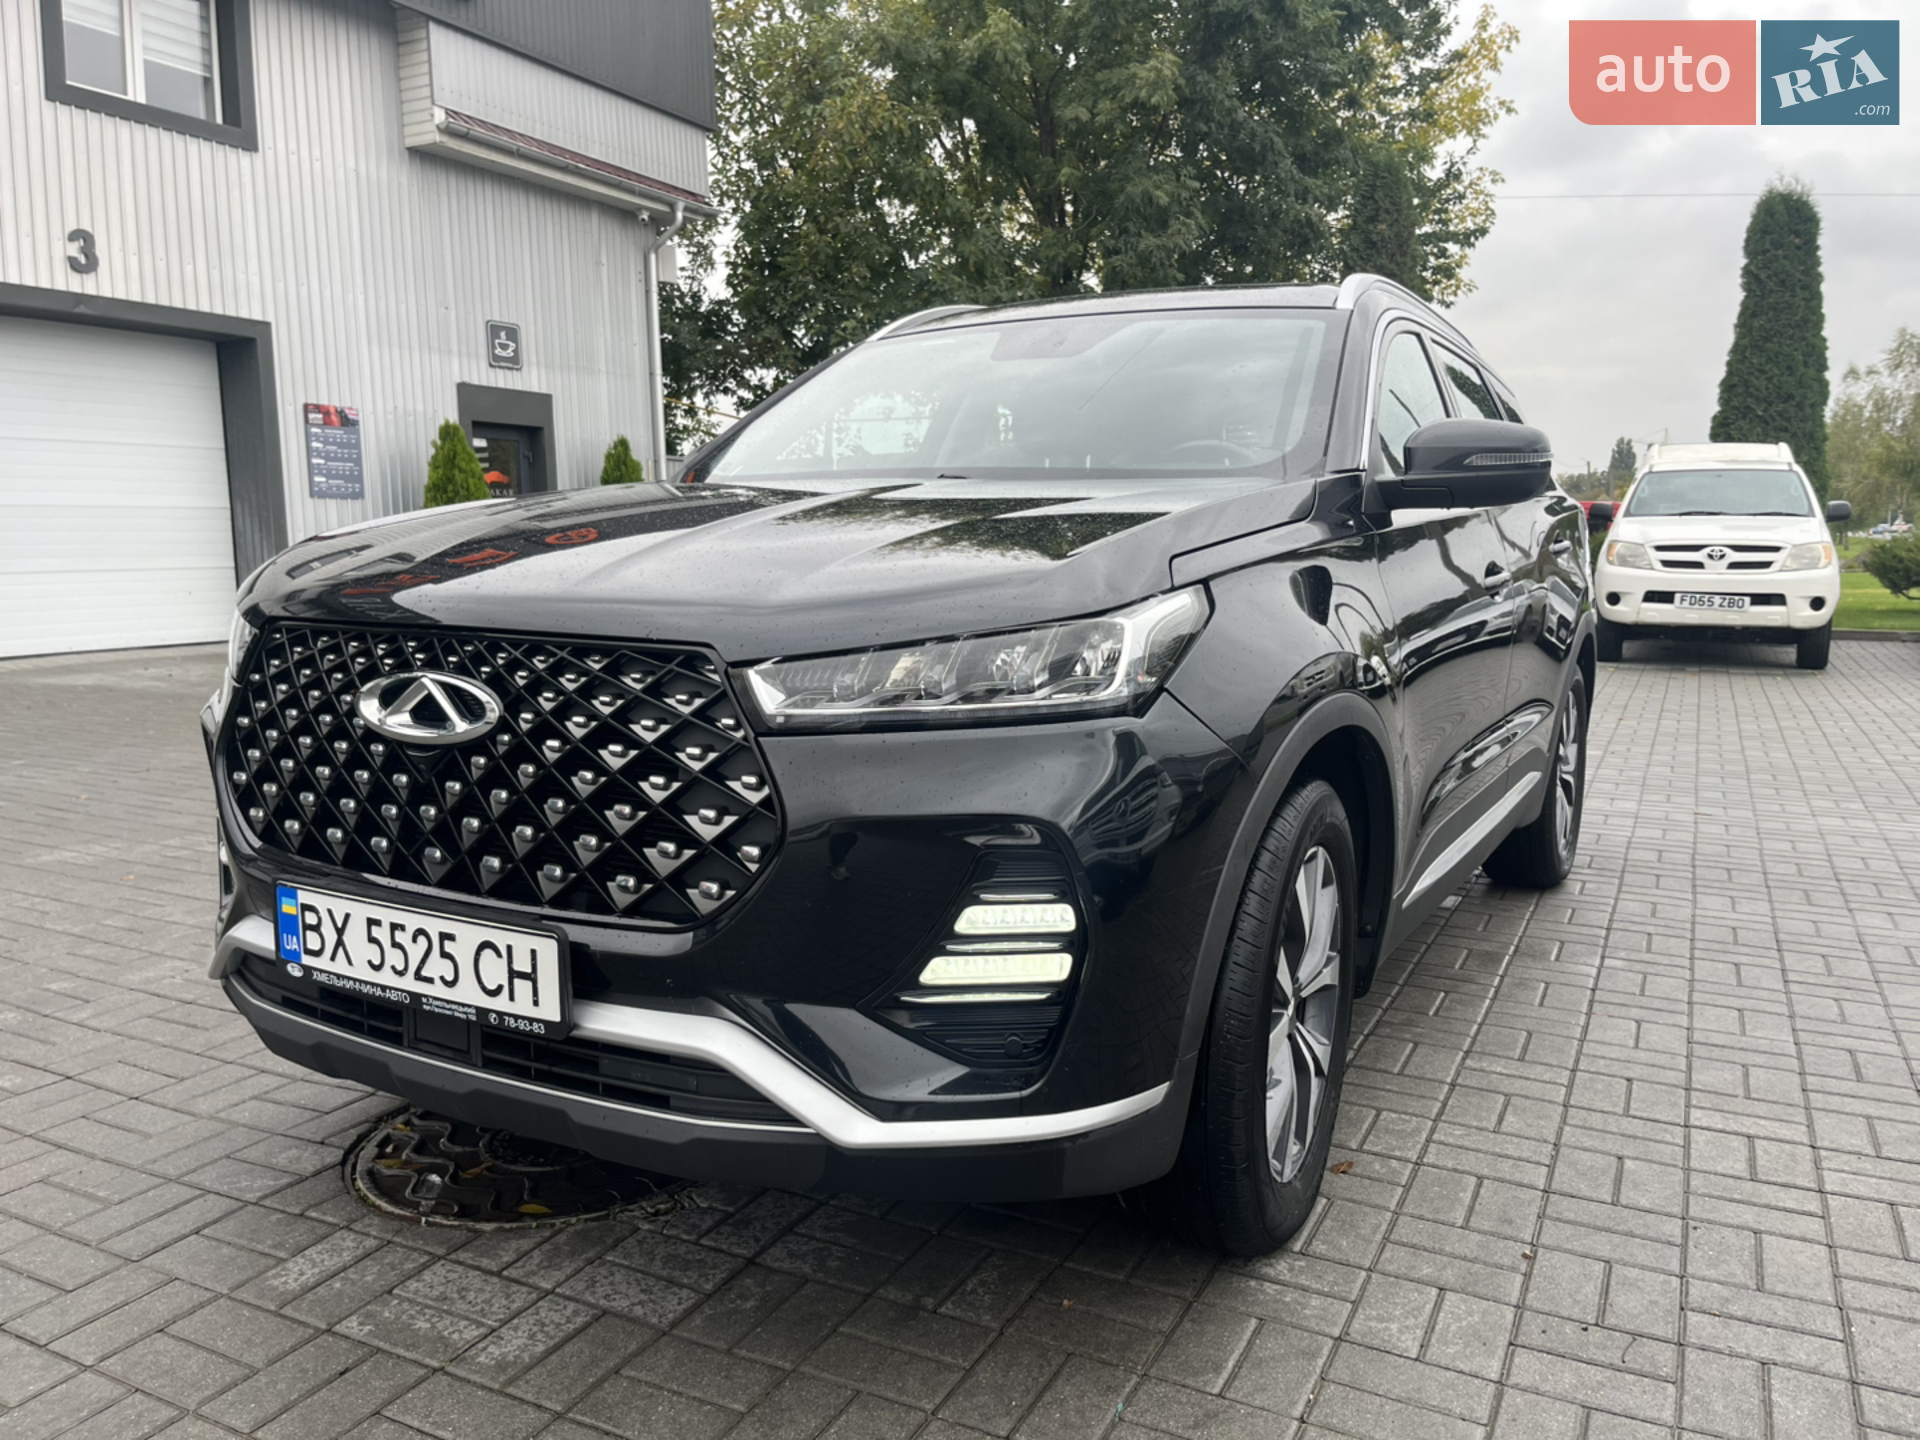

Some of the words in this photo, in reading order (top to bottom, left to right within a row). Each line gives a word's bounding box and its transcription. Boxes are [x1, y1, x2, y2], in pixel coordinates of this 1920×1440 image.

[67, 228, 99, 274] 3
[489, 488, 514, 497] AKAR
[283, 933, 300, 953] UA
[300, 902, 354, 967] BX
[366, 916, 460, 989] 5525
[473, 939, 540, 1007] CH
[503, 1015, 546, 1034] 78-93-83
